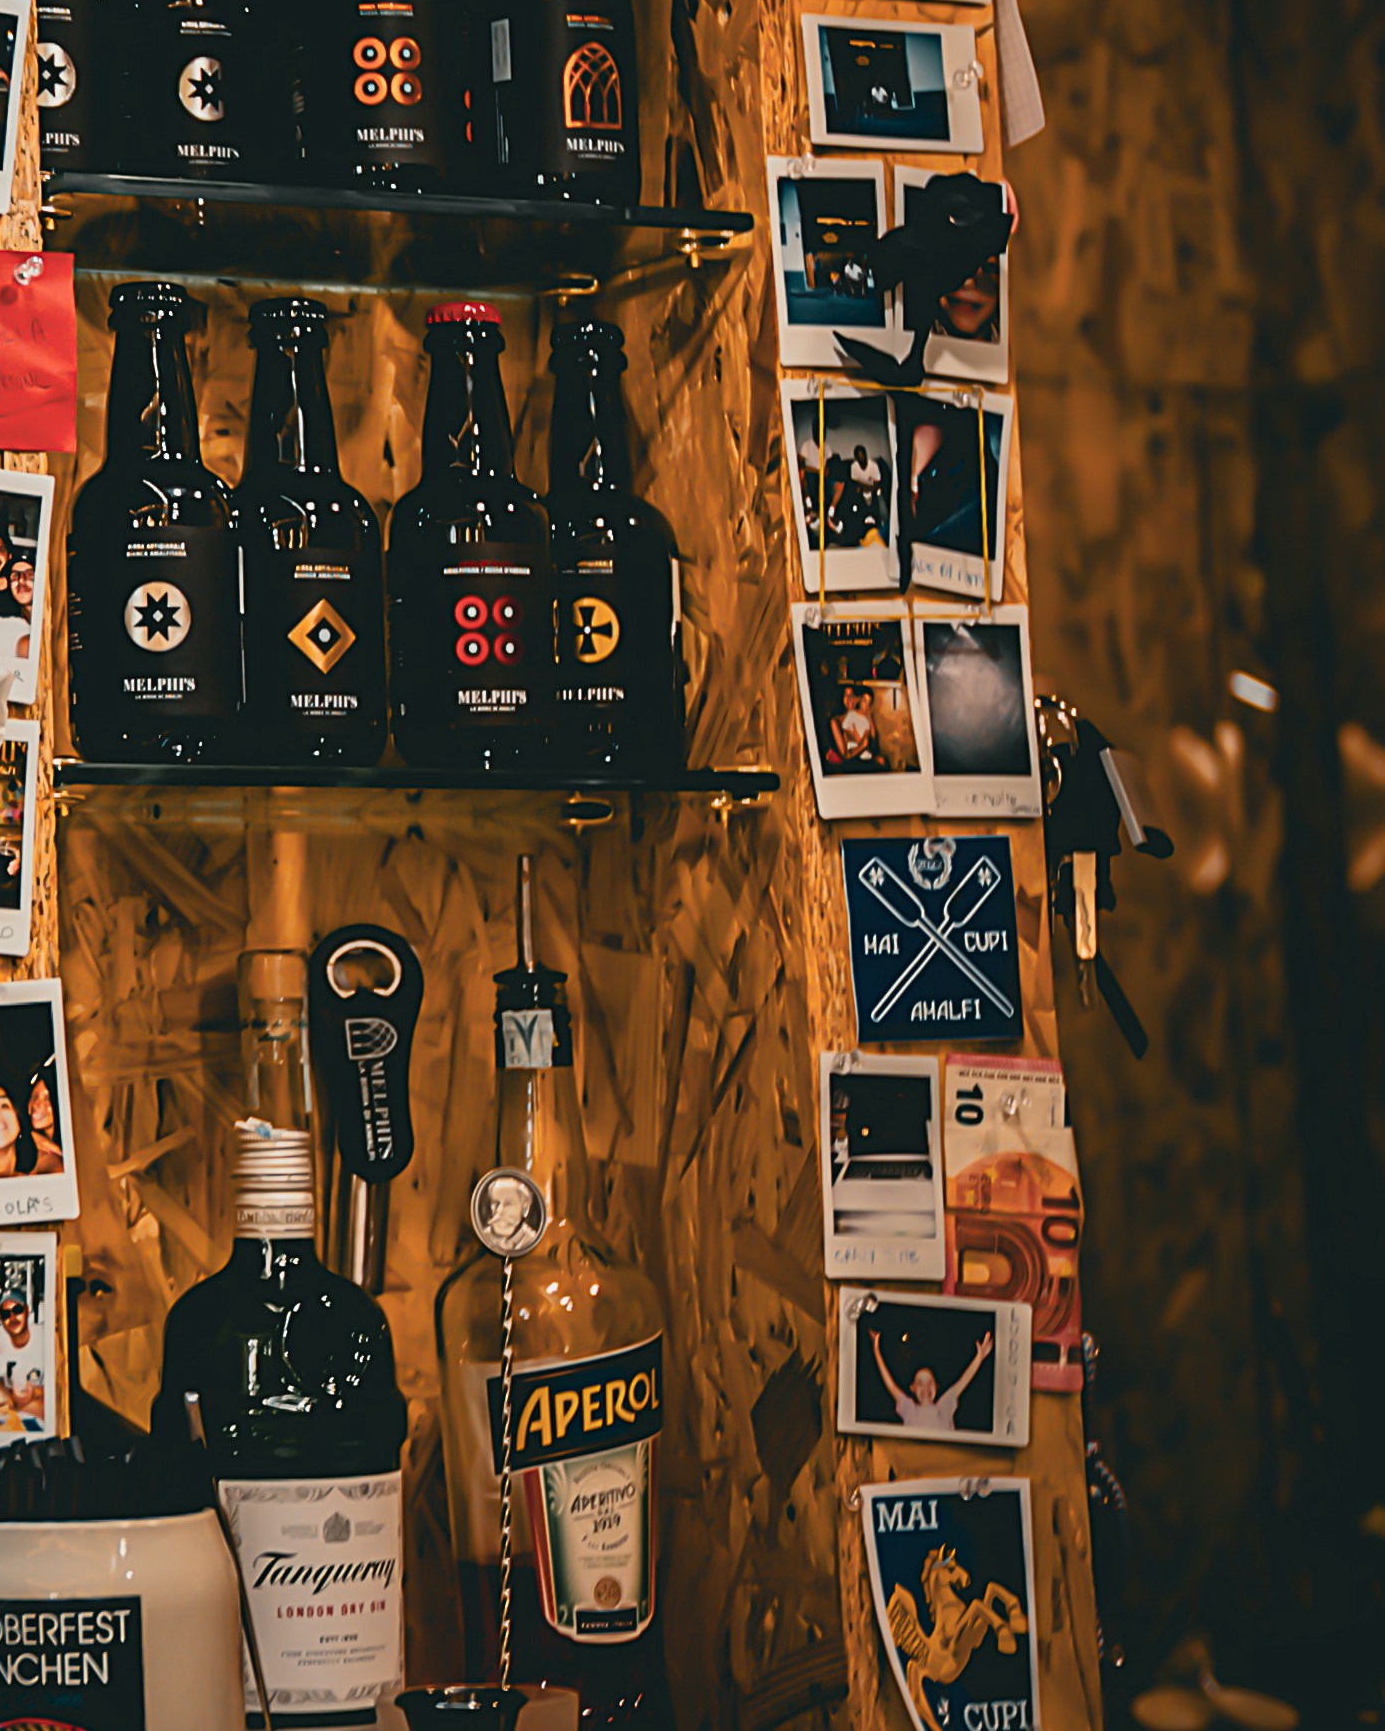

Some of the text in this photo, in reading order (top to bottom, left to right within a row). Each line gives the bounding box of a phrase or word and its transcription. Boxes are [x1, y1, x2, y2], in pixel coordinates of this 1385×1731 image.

[357, 127, 425, 142] MELPHI'S
[566, 137, 625, 154] MELPHI'S
[123, 677, 196, 692] MELPHI'S
[291, 693, 358, 709] MELPHI'S
[457, 689, 527, 705] MELPHI'S
[963, 929, 1008, 953] CUPI
[910, 997, 981, 1022] AMALFI
[955, 1082, 984, 1128] 10
[1041, 1187, 1081, 1248] 10
[516, 1367, 660, 1453] APEROL
[876, 1499, 939, 1533] MAI
[252, 1550, 397, 1595] Tanqueray
[277, 1605, 334, 1619] LONDON
[963, 1699, 1028, 1731] CUPI
